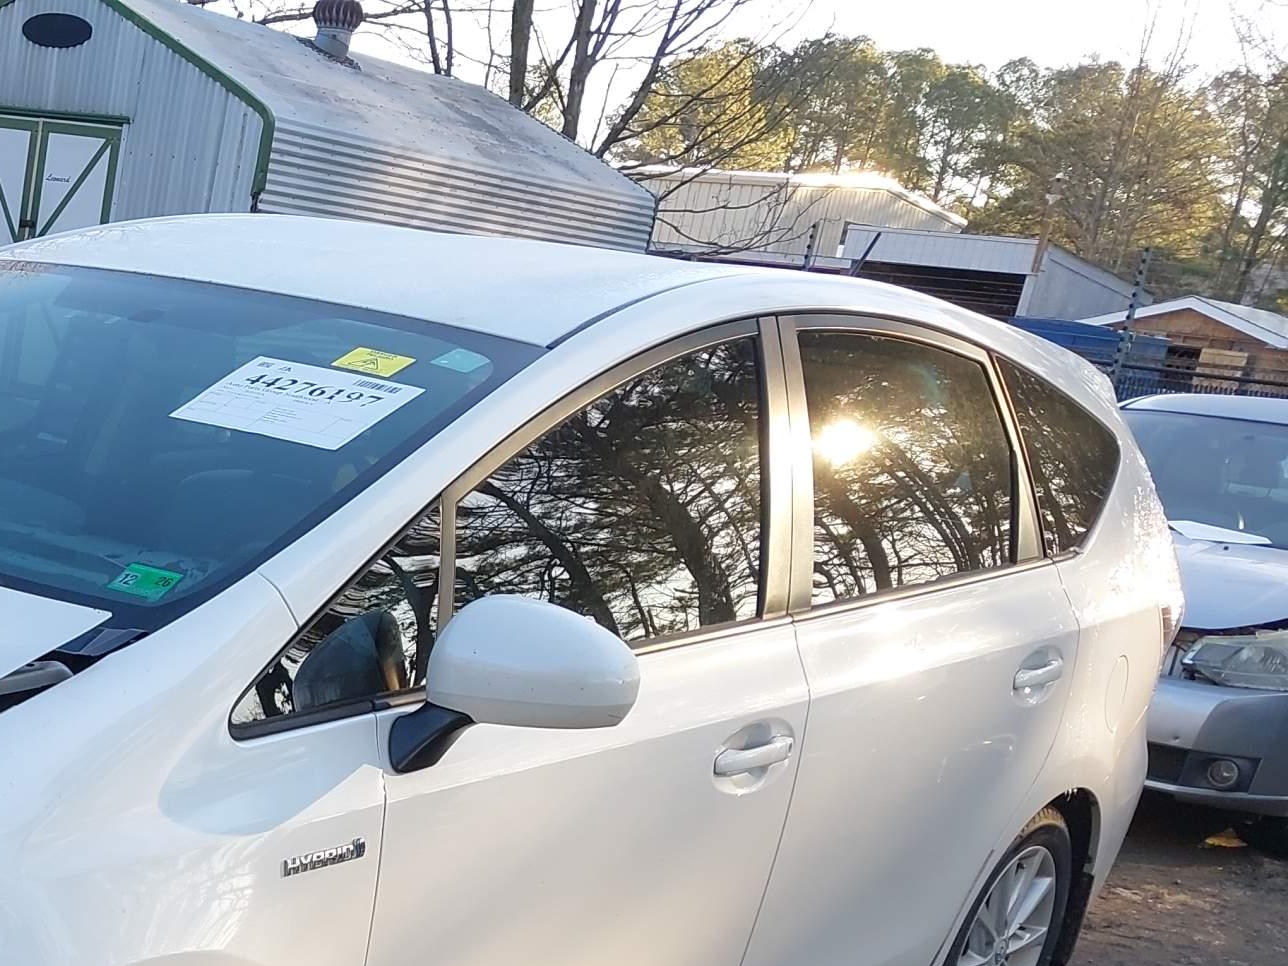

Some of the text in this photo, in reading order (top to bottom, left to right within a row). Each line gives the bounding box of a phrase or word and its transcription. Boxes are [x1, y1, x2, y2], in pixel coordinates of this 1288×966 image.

[245, 374, 385, 408] 44276197
[118, 573, 138, 586] 12
[155, 576, 174, 587] 26
